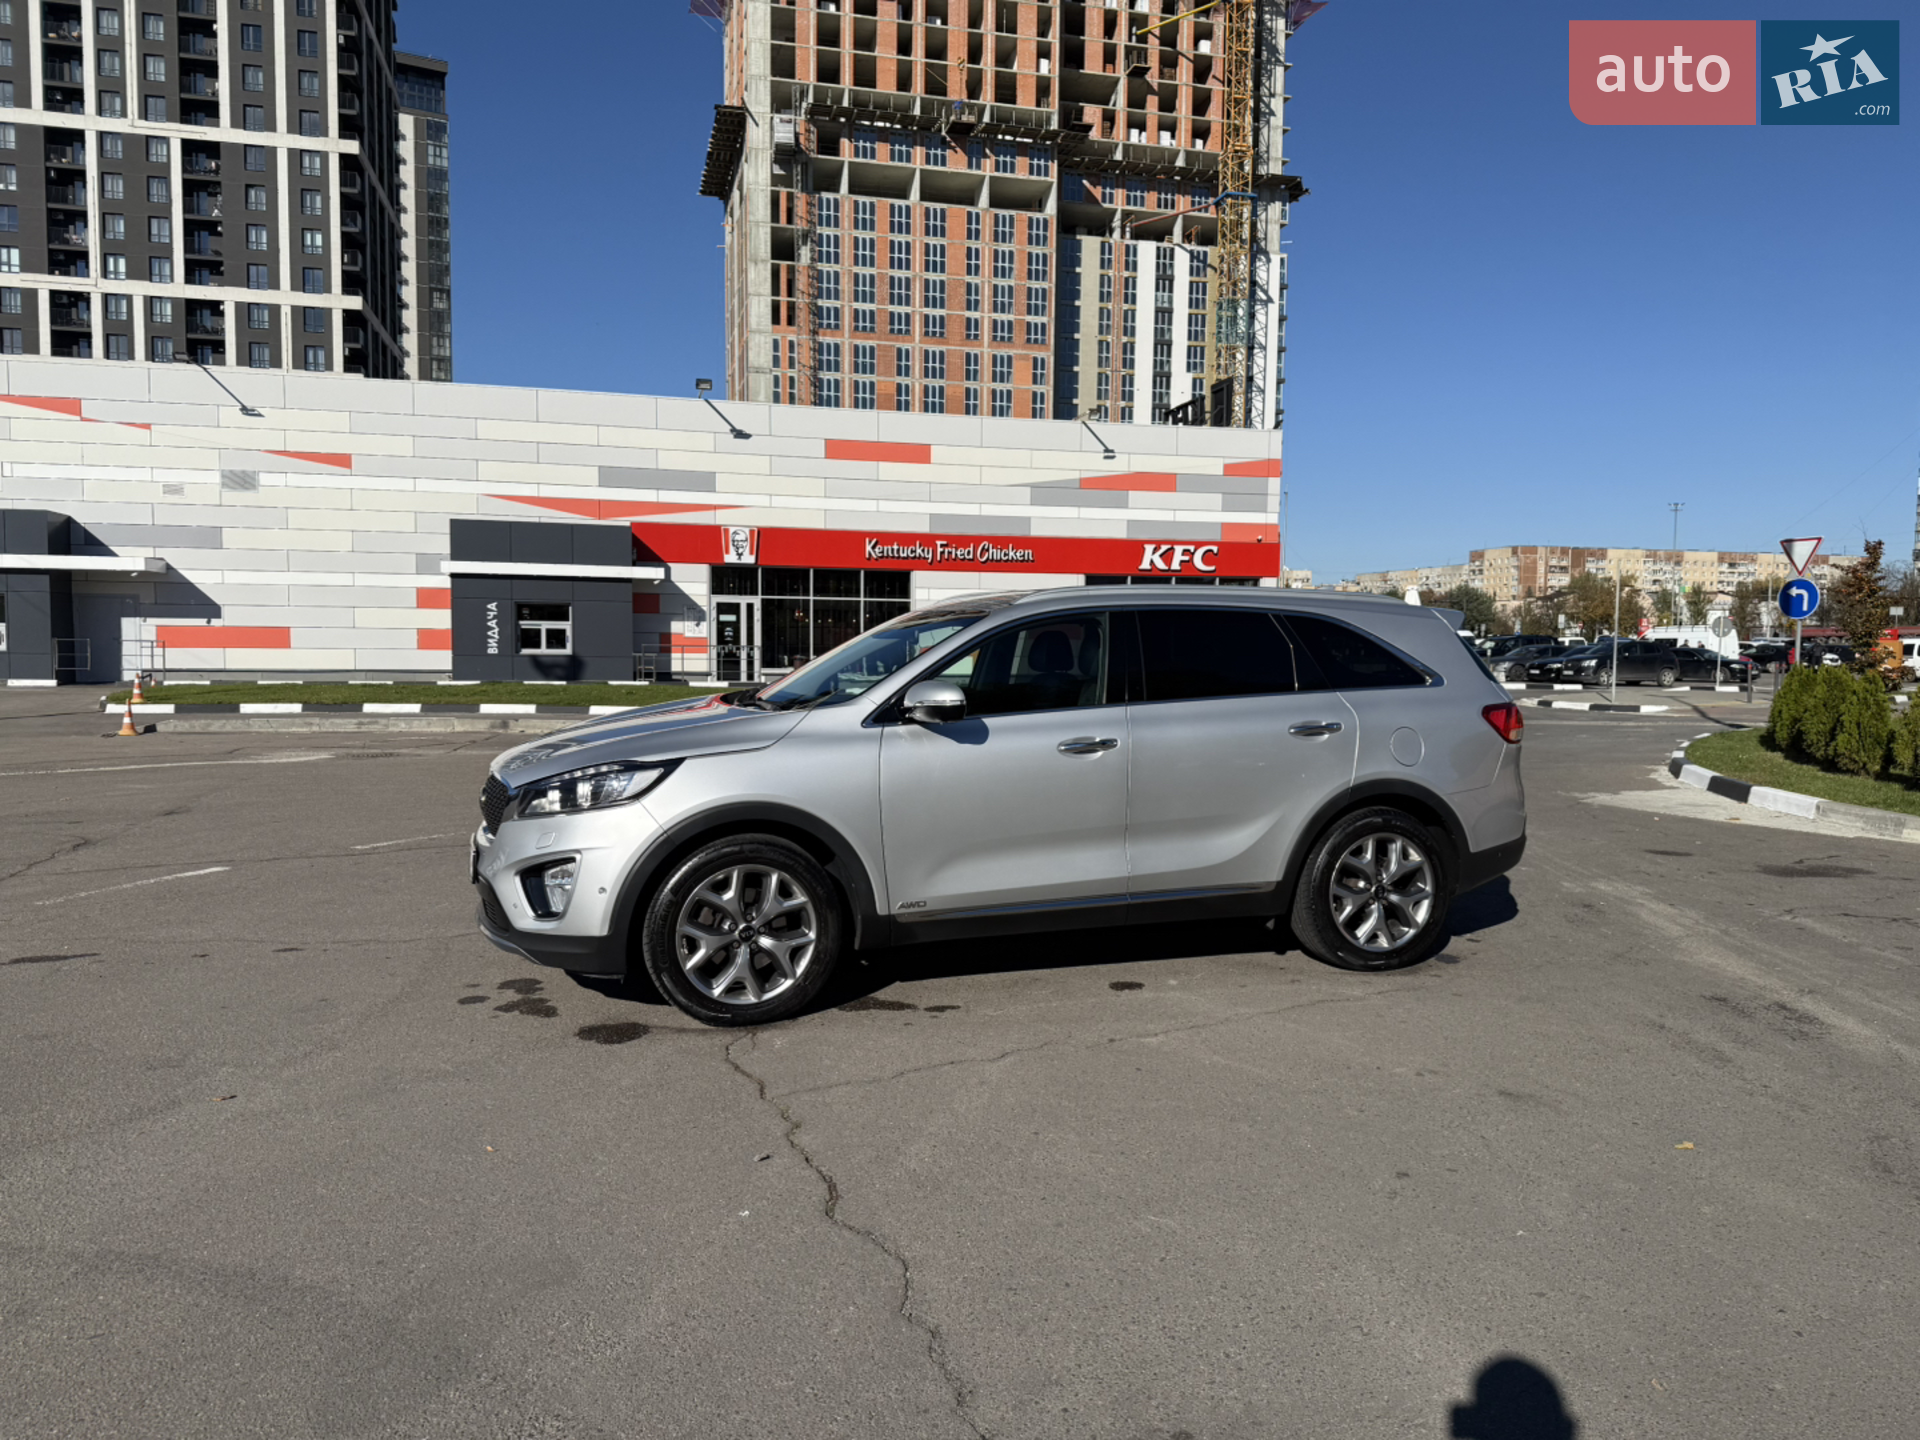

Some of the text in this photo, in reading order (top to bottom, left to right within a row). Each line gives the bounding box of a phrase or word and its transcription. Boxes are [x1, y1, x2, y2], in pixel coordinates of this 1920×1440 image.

[865, 537, 1034, 563] Kentucky Fried Chicken
[1138, 544, 1219, 572] KFC
[486, 601, 500, 654] ВИДАЧА
[896, 900, 928, 910] AWD
